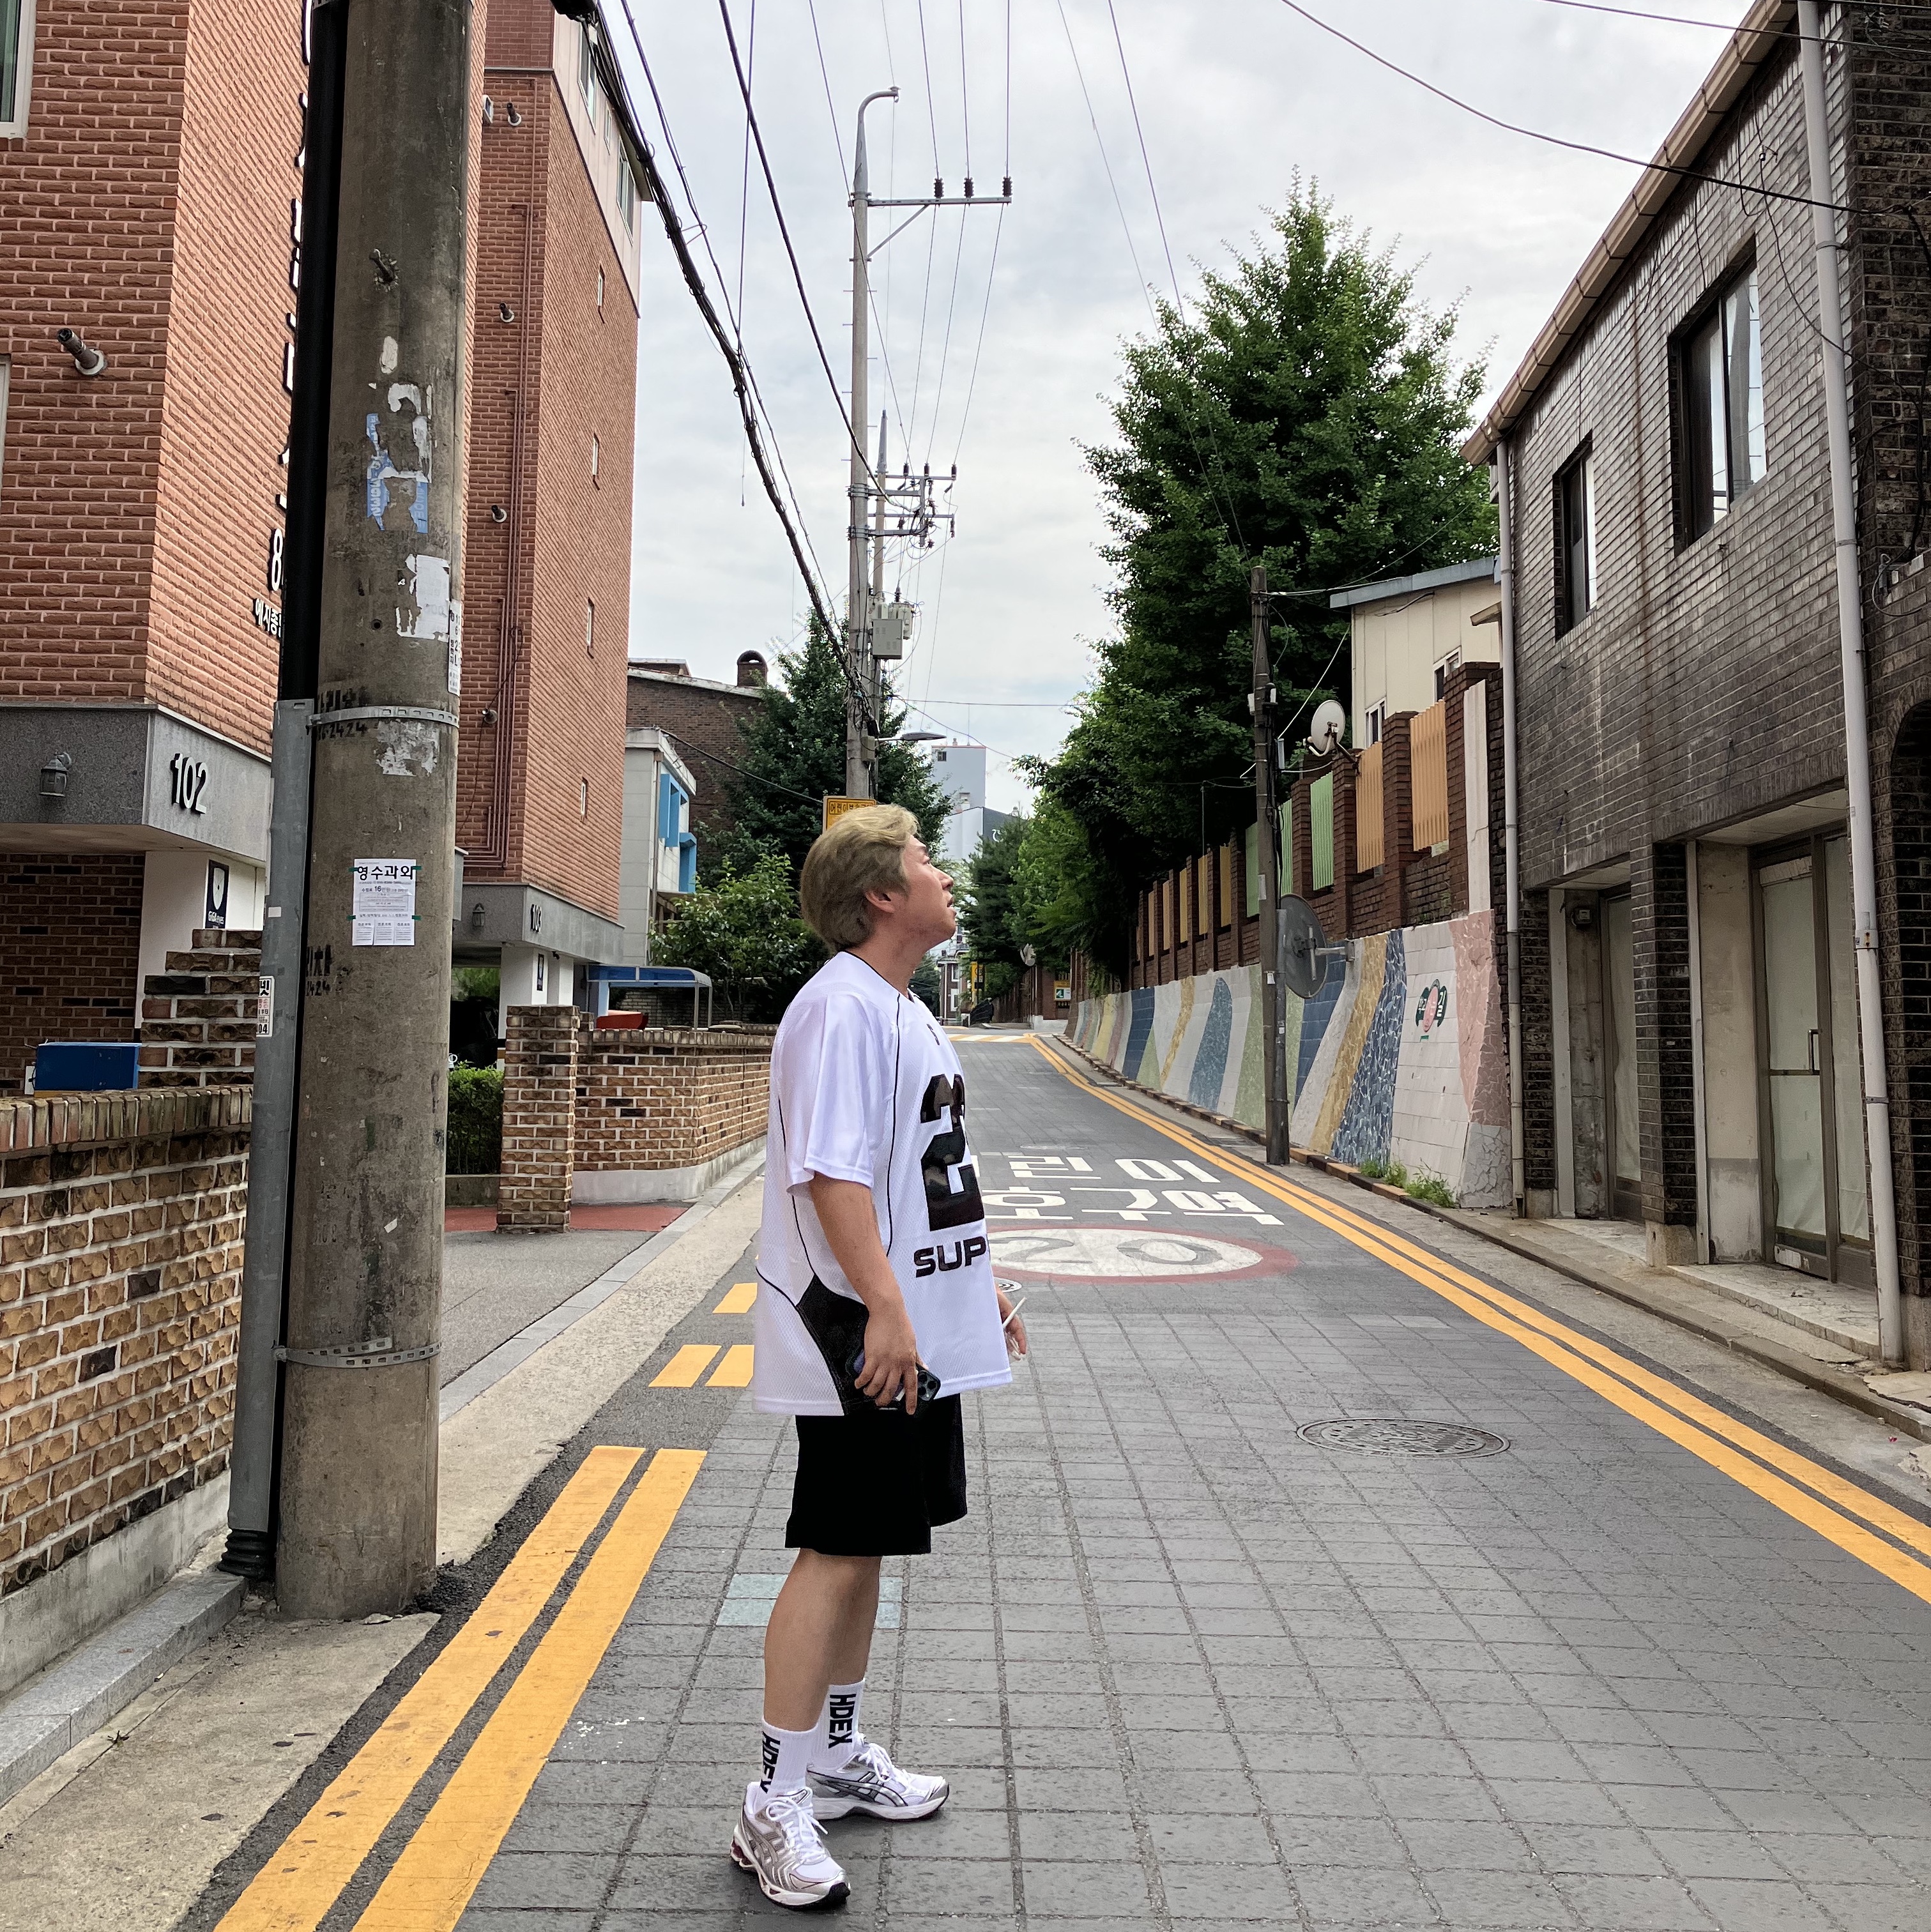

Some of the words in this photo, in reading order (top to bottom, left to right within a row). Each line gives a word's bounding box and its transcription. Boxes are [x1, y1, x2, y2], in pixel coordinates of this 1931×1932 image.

[171, 753, 209, 814] 102
[358, 865, 413, 881] 영수과외
[971, 1155, 1221, 1183] 린이
[828, 1693, 857, 1749] HDEX
